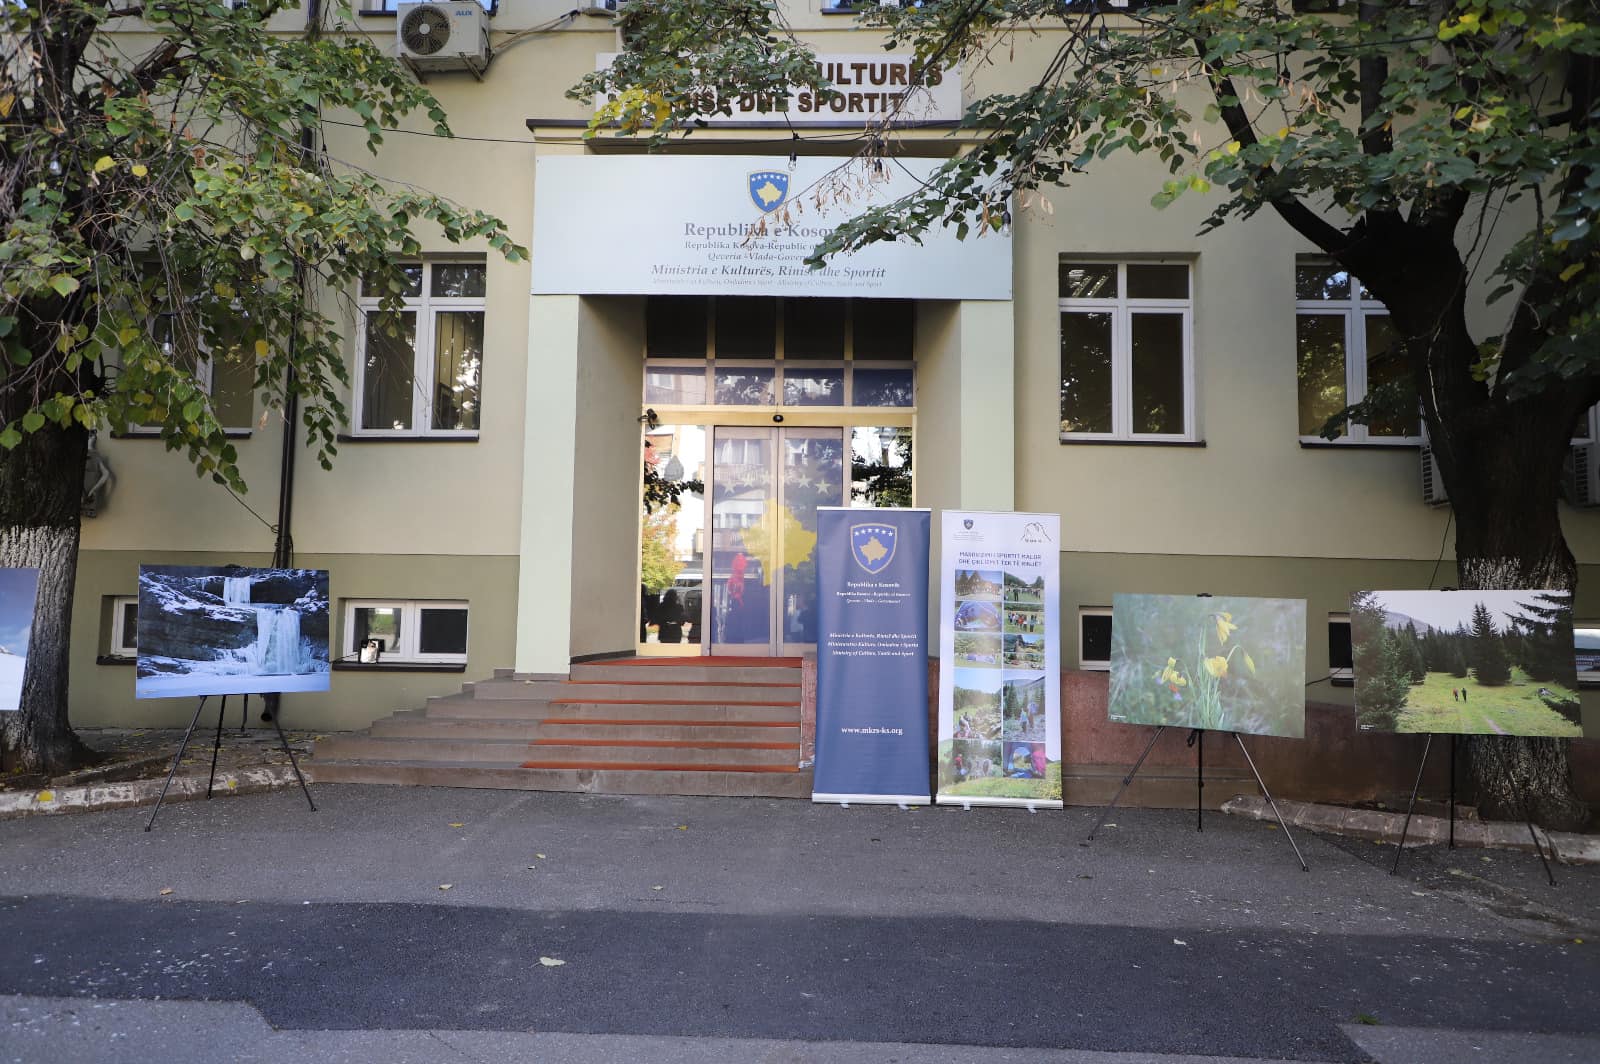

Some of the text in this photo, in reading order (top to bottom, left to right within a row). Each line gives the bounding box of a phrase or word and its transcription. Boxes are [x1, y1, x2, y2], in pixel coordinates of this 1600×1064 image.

[798, 92, 905, 113] SPORTIT
[788, 224, 835, 237] Kosov
[651, 264, 708, 275] Ministria
[711, 267, 718, 275] e
[843, 266, 887, 280] Sportit
[841, 726, 903, 736] www.mkrs-ks.org
